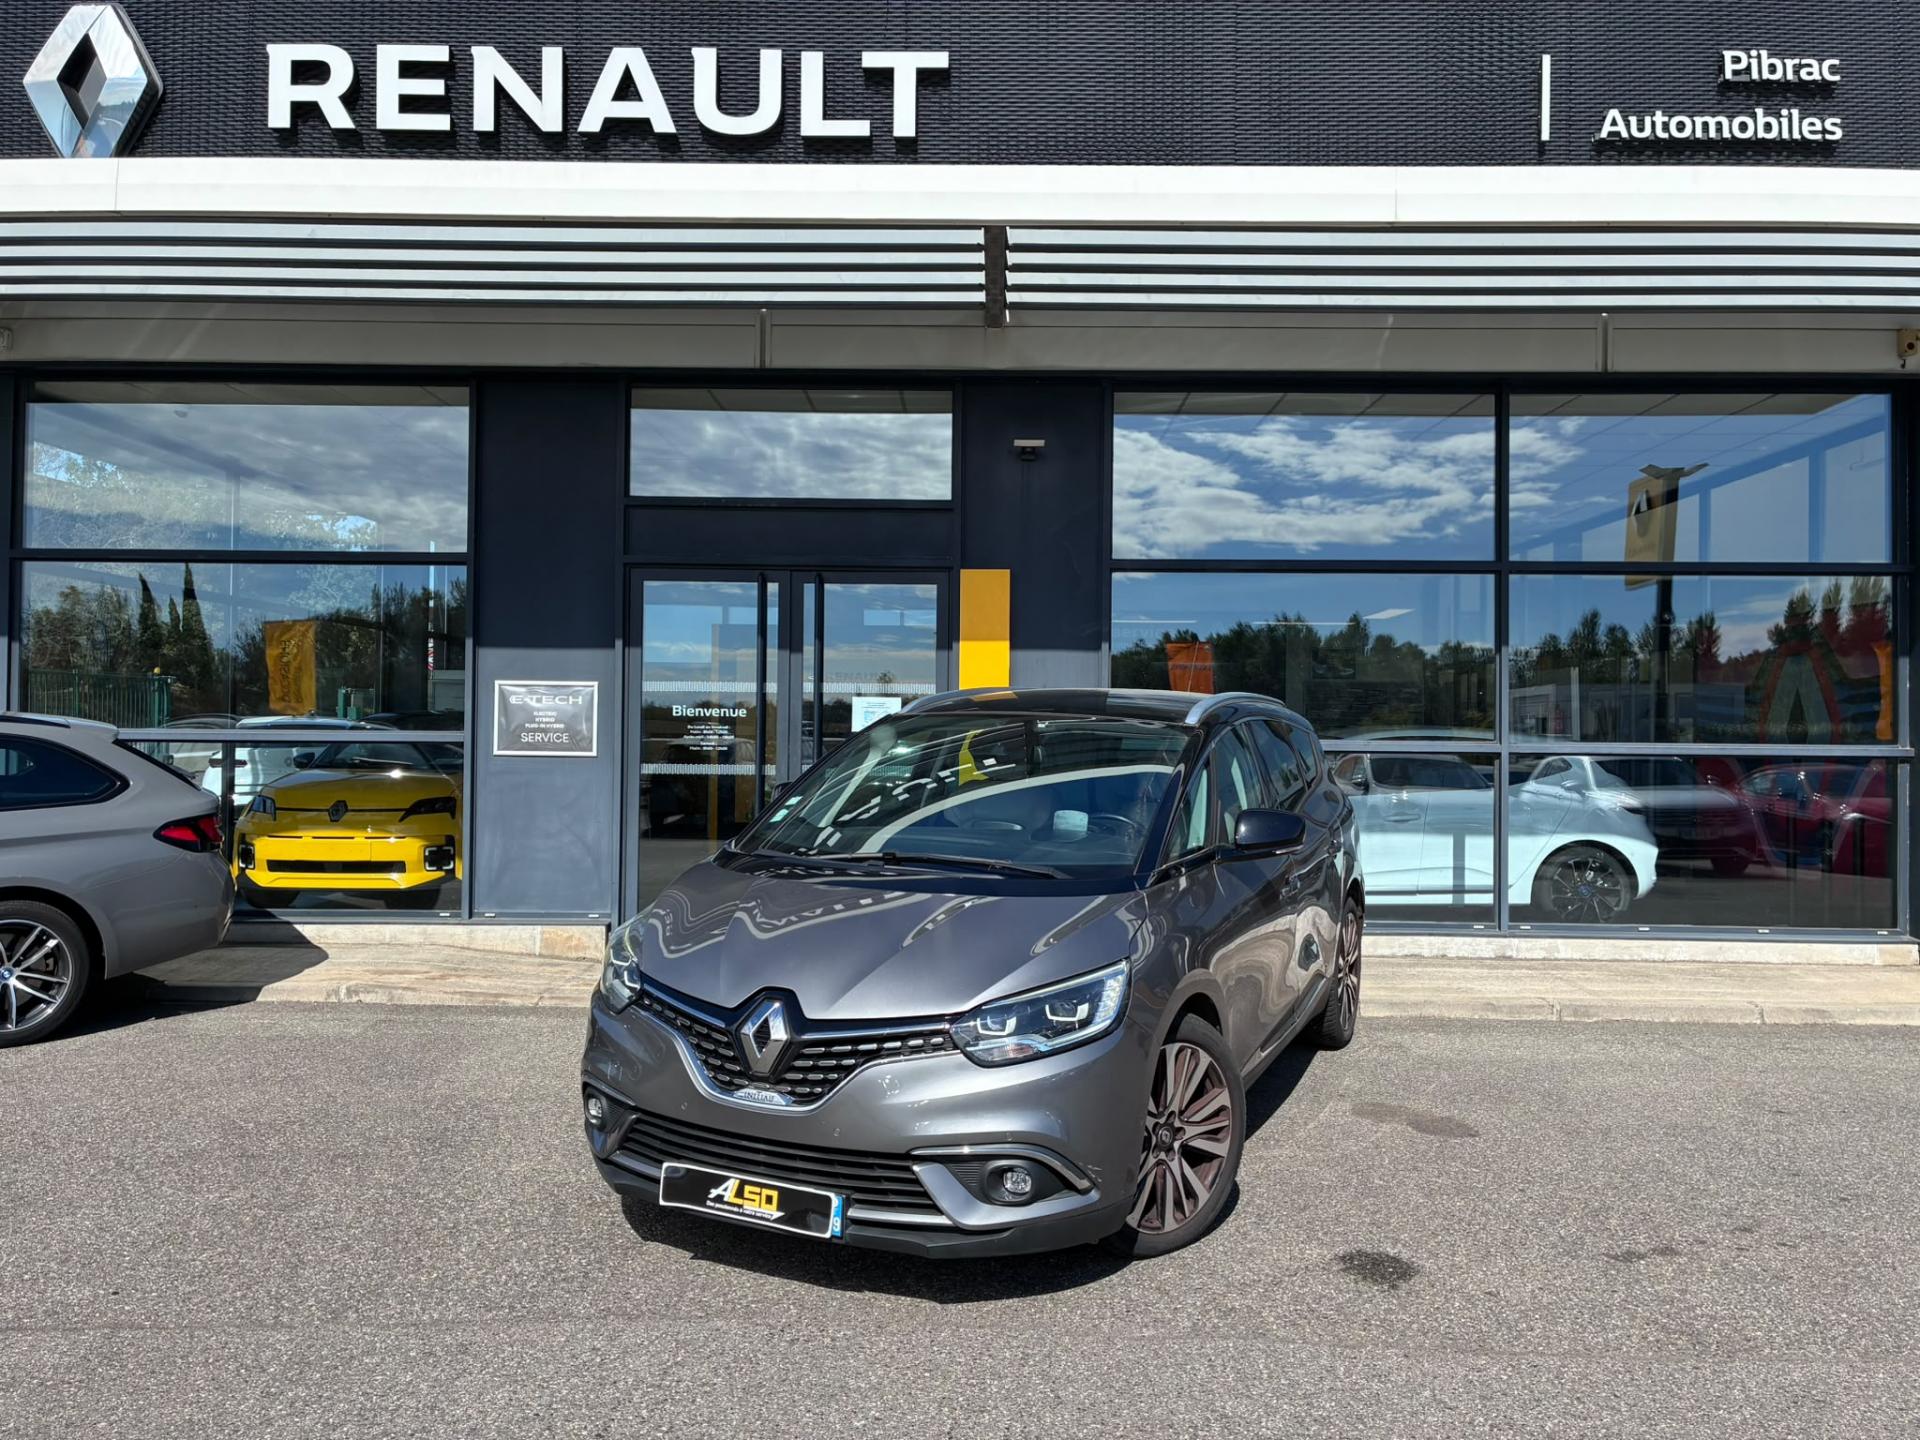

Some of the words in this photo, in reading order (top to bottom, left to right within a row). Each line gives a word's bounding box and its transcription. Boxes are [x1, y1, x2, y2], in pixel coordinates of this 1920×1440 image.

[1722, 50, 1841, 82] Pibrac
[266, 43, 951, 137] RENAULT
[1600, 108, 1844, 141] Automobiles
[672, 705, 747, 718] Bienvenue
[520, 732, 569, 743] SERVICE
[707, 1177, 779, 1212] ALSO
